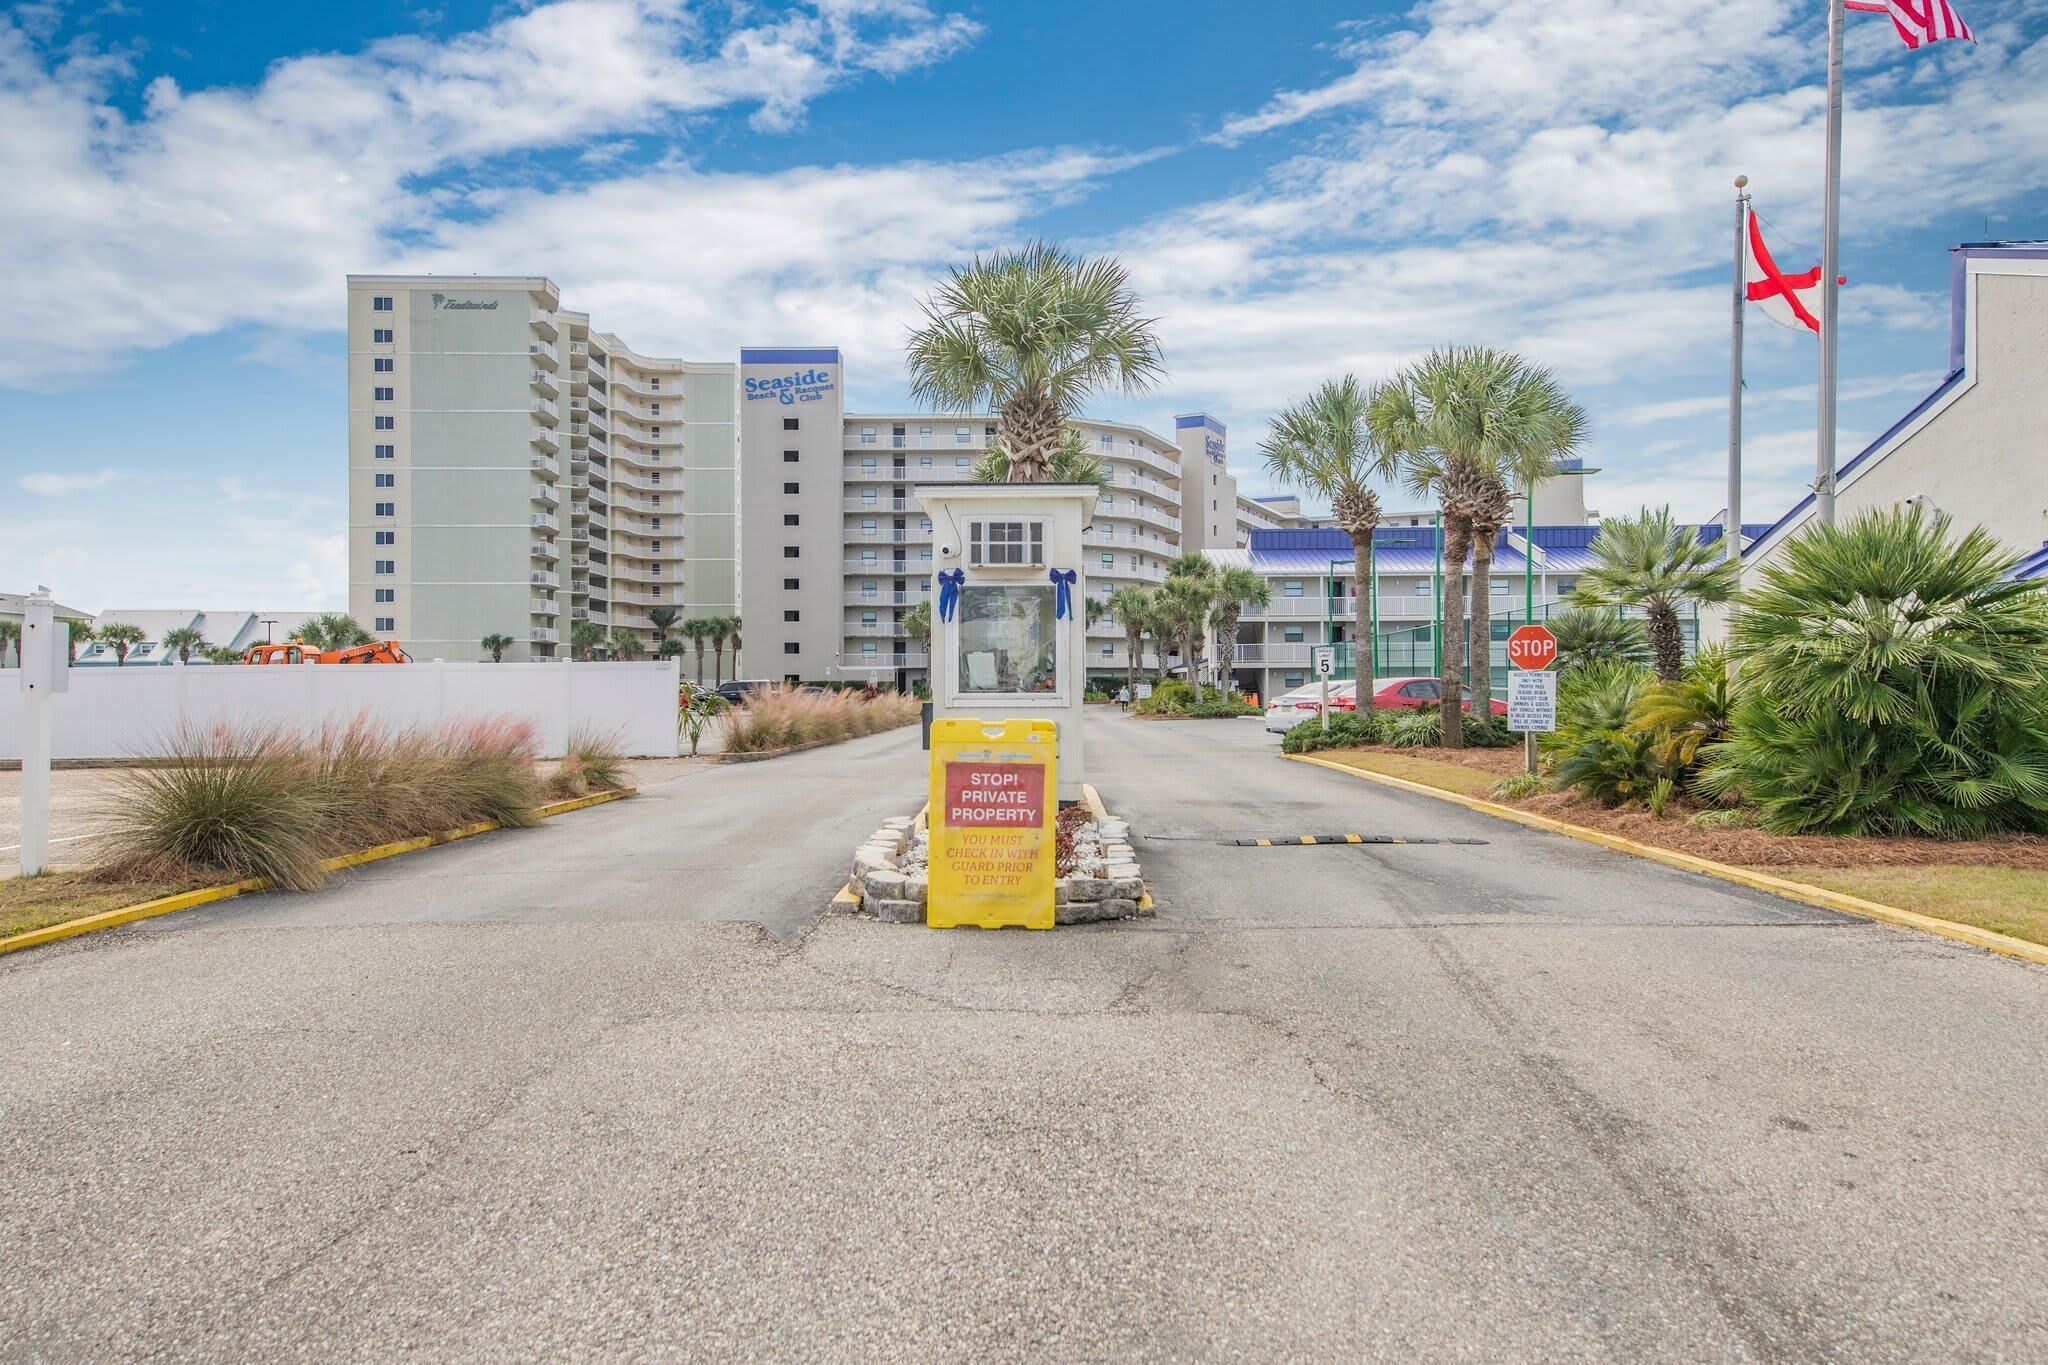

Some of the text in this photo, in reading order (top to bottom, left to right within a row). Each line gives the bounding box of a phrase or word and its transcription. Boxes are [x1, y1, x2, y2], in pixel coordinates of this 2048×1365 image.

[443, 299, 499, 309] Tradewinds
[745, 368, 829, 393] Seaside
[747, 383, 834, 405] Beach & Racquet
[799, 392, 823, 402] Club
[1511, 640, 1554, 657] STOP
[1321, 660, 1330, 672] 5
[970, 773, 1018, 786] STOP!
[962, 790, 1027, 803] PRIVATE
[952, 808, 1036, 821] PROPERTY
[963, 835, 1024, 845] YOU MUST
[946, 848, 1039, 859] CHECK IN WITH
[952, 862, 1033, 872] GUARD PRIOR
[963, 875, 1022, 886] TO ENTRY
